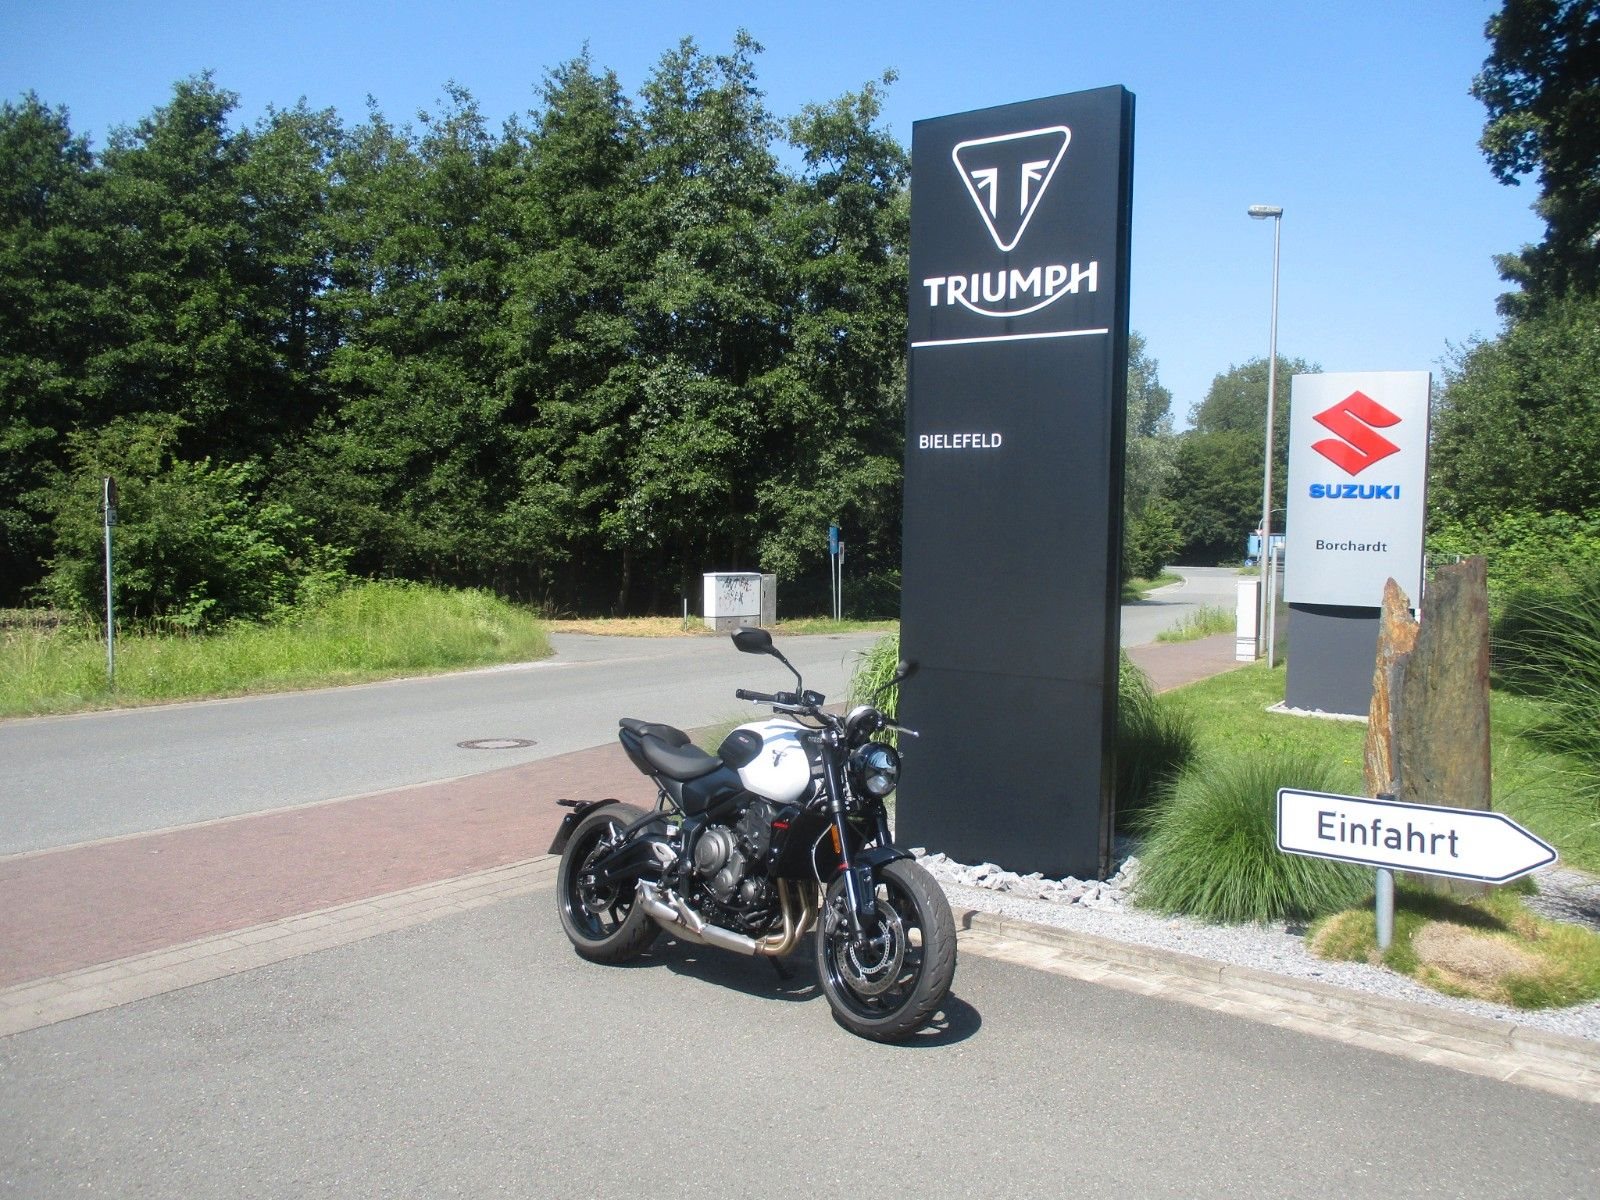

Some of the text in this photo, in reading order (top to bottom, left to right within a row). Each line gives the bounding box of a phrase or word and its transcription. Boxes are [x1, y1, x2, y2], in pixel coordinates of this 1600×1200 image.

[923, 261, 1098, 317] TRIUMPH
[919, 433, 1002, 449] BIELEFELD
[1309, 483, 1400, 500] SUZUKI
[1316, 539, 1388, 552] Borchardt
[1318, 810, 1459, 858] Einfahrt
